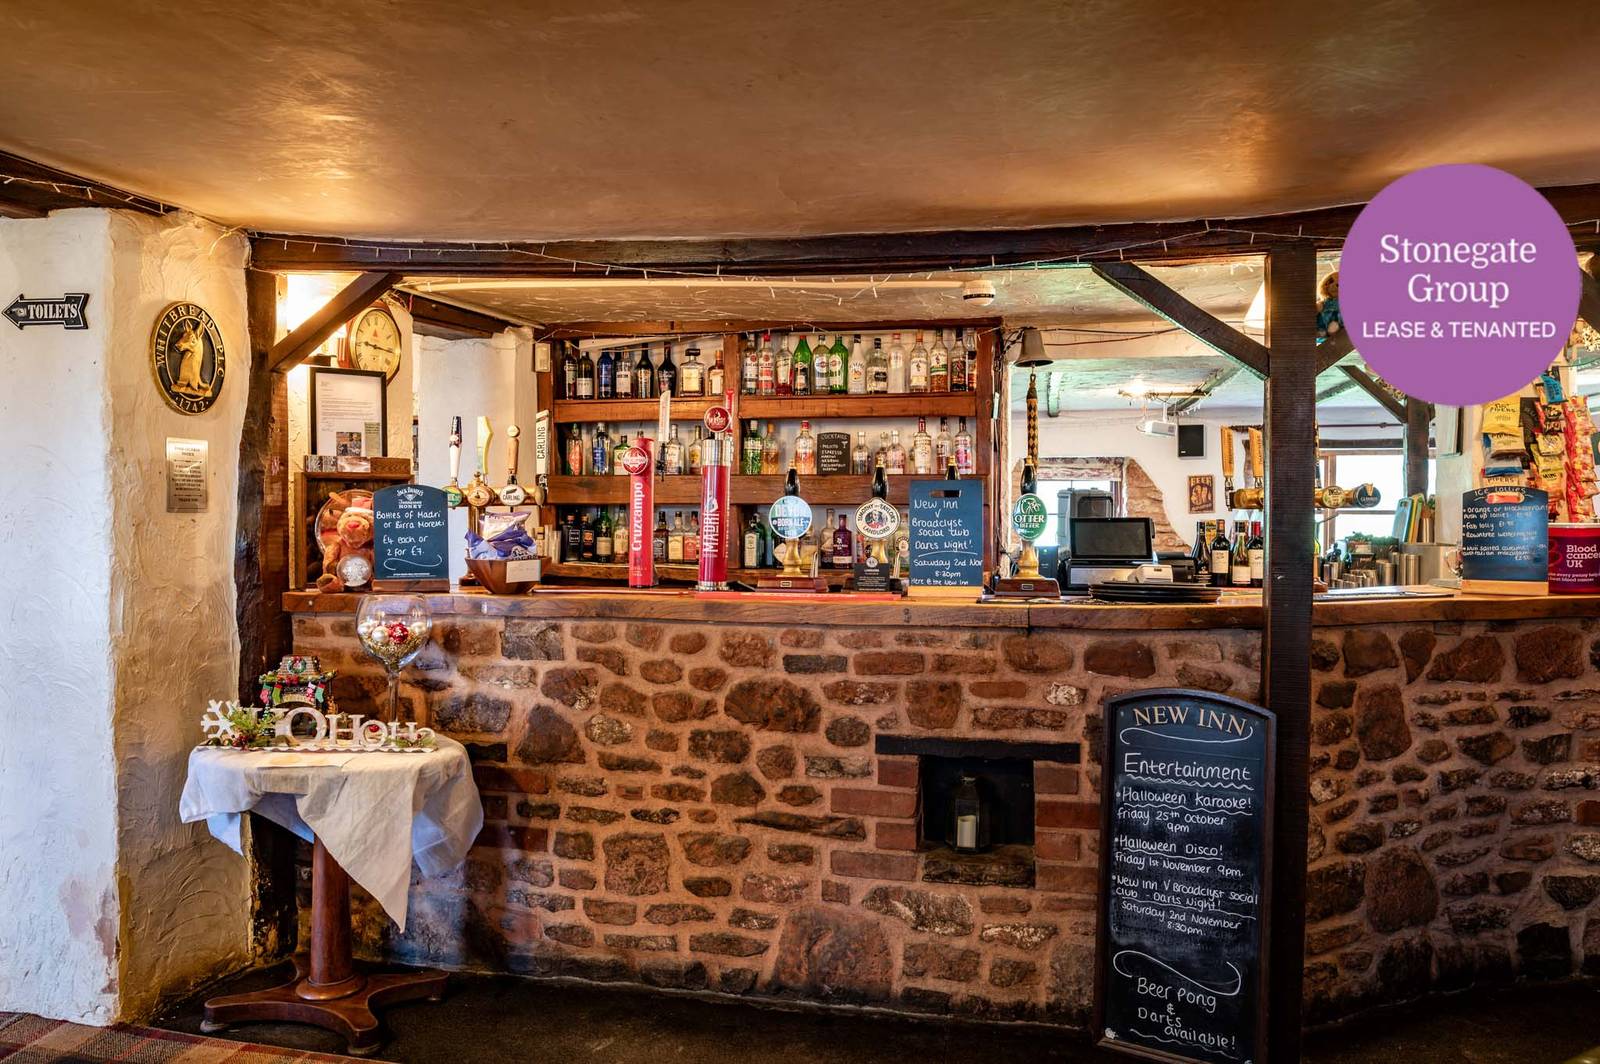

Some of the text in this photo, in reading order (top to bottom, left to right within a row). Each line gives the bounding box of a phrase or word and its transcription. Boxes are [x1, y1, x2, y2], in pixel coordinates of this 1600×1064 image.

[28, 304, 78, 319] TOILETS
[155, 304, 224, 378] WHITBREAD PLC
[178, 400, 206, 412] 1742
[536, 426, 546, 459] CARLING
[1191, 478, 1212, 488] BEER
[914, 500, 958, 509] New Inn
[404, 511, 414, 519] of
[632, 482, 644, 552] Cruzcampo
[858, 504, 874, 522] TIMOTHY
[1014, 514, 1045, 523] OTTER
[395, 521, 414, 529] Birra
[863, 526, 890, 535] LANDLORD
[912, 518, 962, 532] Broadclyst
[383, 535, 394, 544] £4
[915, 541, 938, 550] Darts
[1566, 544, 1597, 552] Blood
[913, 559, 950, 570] Saturday
[1133, 706, 1246, 736] NEW INN
[1124, 753, 1251, 780] Entertainment
[1123, 787, 1187, 804] Halloween
[1156, 811, 1180, 820] 25th
[1185, 814, 1226, 825] October
[1167, 823, 1190, 833] 9pm
[1120, 835, 1223, 856] Halloween Disco!
[1150, 856, 1159, 866] 1st
[1163, 858, 1211, 873] November
[1117, 876, 1139, 888] New
[1173, 882, 1224, 901] Broadclyst
[1154, 892, 1181, 905] Darts
[1186, 898, 1220, 912] Night!
[1122, 901, 1241, 929] Saturday 2nd November
[1137, 977, 1172, 1000] Beer
[1138, 1007, 1182, 1028] Darts
[1164, 1026, 1236, 1050] available!
